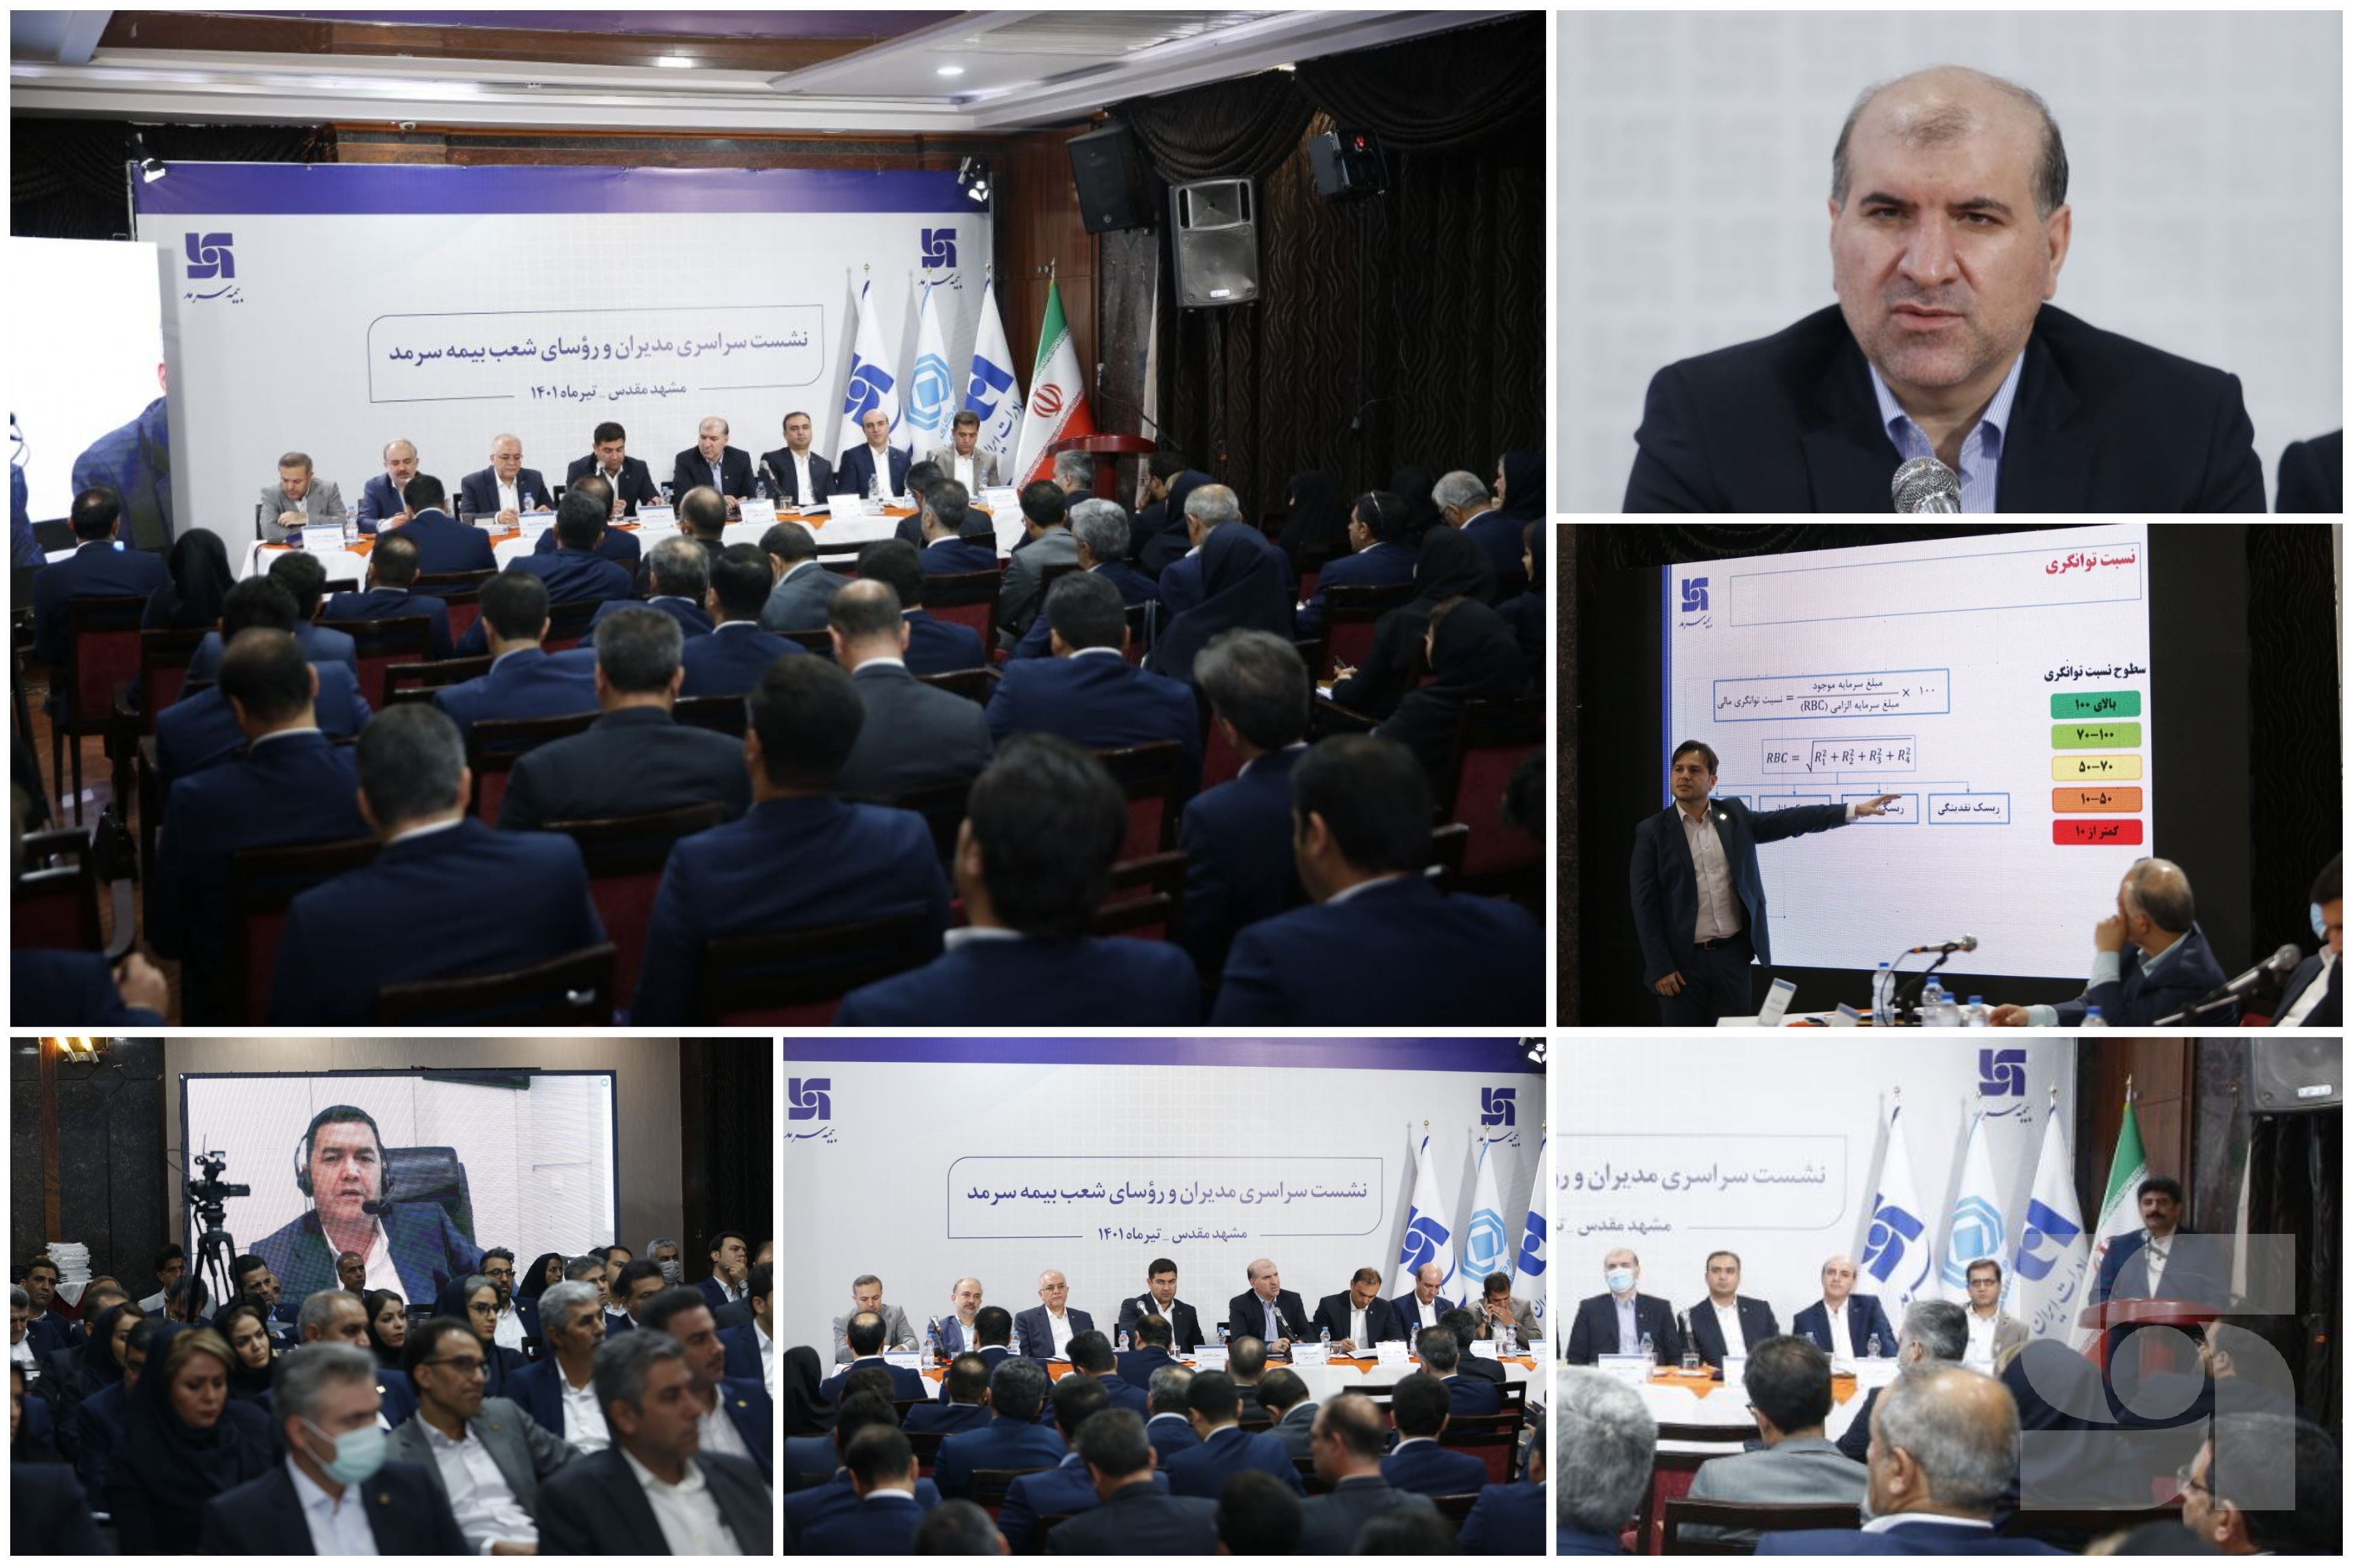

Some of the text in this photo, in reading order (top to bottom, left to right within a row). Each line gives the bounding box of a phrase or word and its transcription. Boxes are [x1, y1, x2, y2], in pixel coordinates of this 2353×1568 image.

[183, 285, 233, 304] سرمد
[389, 330, 808, 366] نشست سراسری مدیران و رؤسای شعب بیمه سرمد
[531, 386, 558, 401] ۱۴۰۱
[560, 385, 597, 402] تیرماه
[609, 382, 648, 401] مقدس
[649, 382, 687, 397] مشهد
[2045, 548, 2136, 575] نسبت توانگری
[2044, 662, 2147, 682] سطوح نسبت توانگری
[1812, 678, 1883, 693] مبلغ سرمایه موجود
[1717, 696, 1732, 709] مالی
[1734, 695, 1760, 708] توانگری
[1761, 695, 1783, 706] نسبت
[1800, 698, 1900, 714] مبلغ سرمایه الزامی (RBC)
[2075, 697, 2117, 712] بالای ۱۰۰
[1766, 752, 1788, 764] RBC
[1937, 803, 2000, 816] ریسک نقدینگی
[2076, 825, 2120, 840] کمتر از ۱۰
[783, 1126, 838, 1144] بیمه سرمد
[1574, 1173, 1584, 1191] و
[1587, 1162, 1659, 1192] مدیران
[1661, 1163, 1749, 1192] سراسری
[1753, 1164, 1827, 1184] نشست
[967, 1180, 1368, 1205] نشست سراسری مدیران و رؤسای شعب بیمه سرمد
[1098, 1226, 1124, 1241] ۱۴۰۱
[1126, 1226, 1162, 1244] تیرماه
[1212, 1226, 1248, 1243] مشهد
[1577, 1217, 1625, 1237] مقدس
[1627, 1218, 1672, 1235] مشهد
[1172, 1227, 1210, 1244] مقدس
